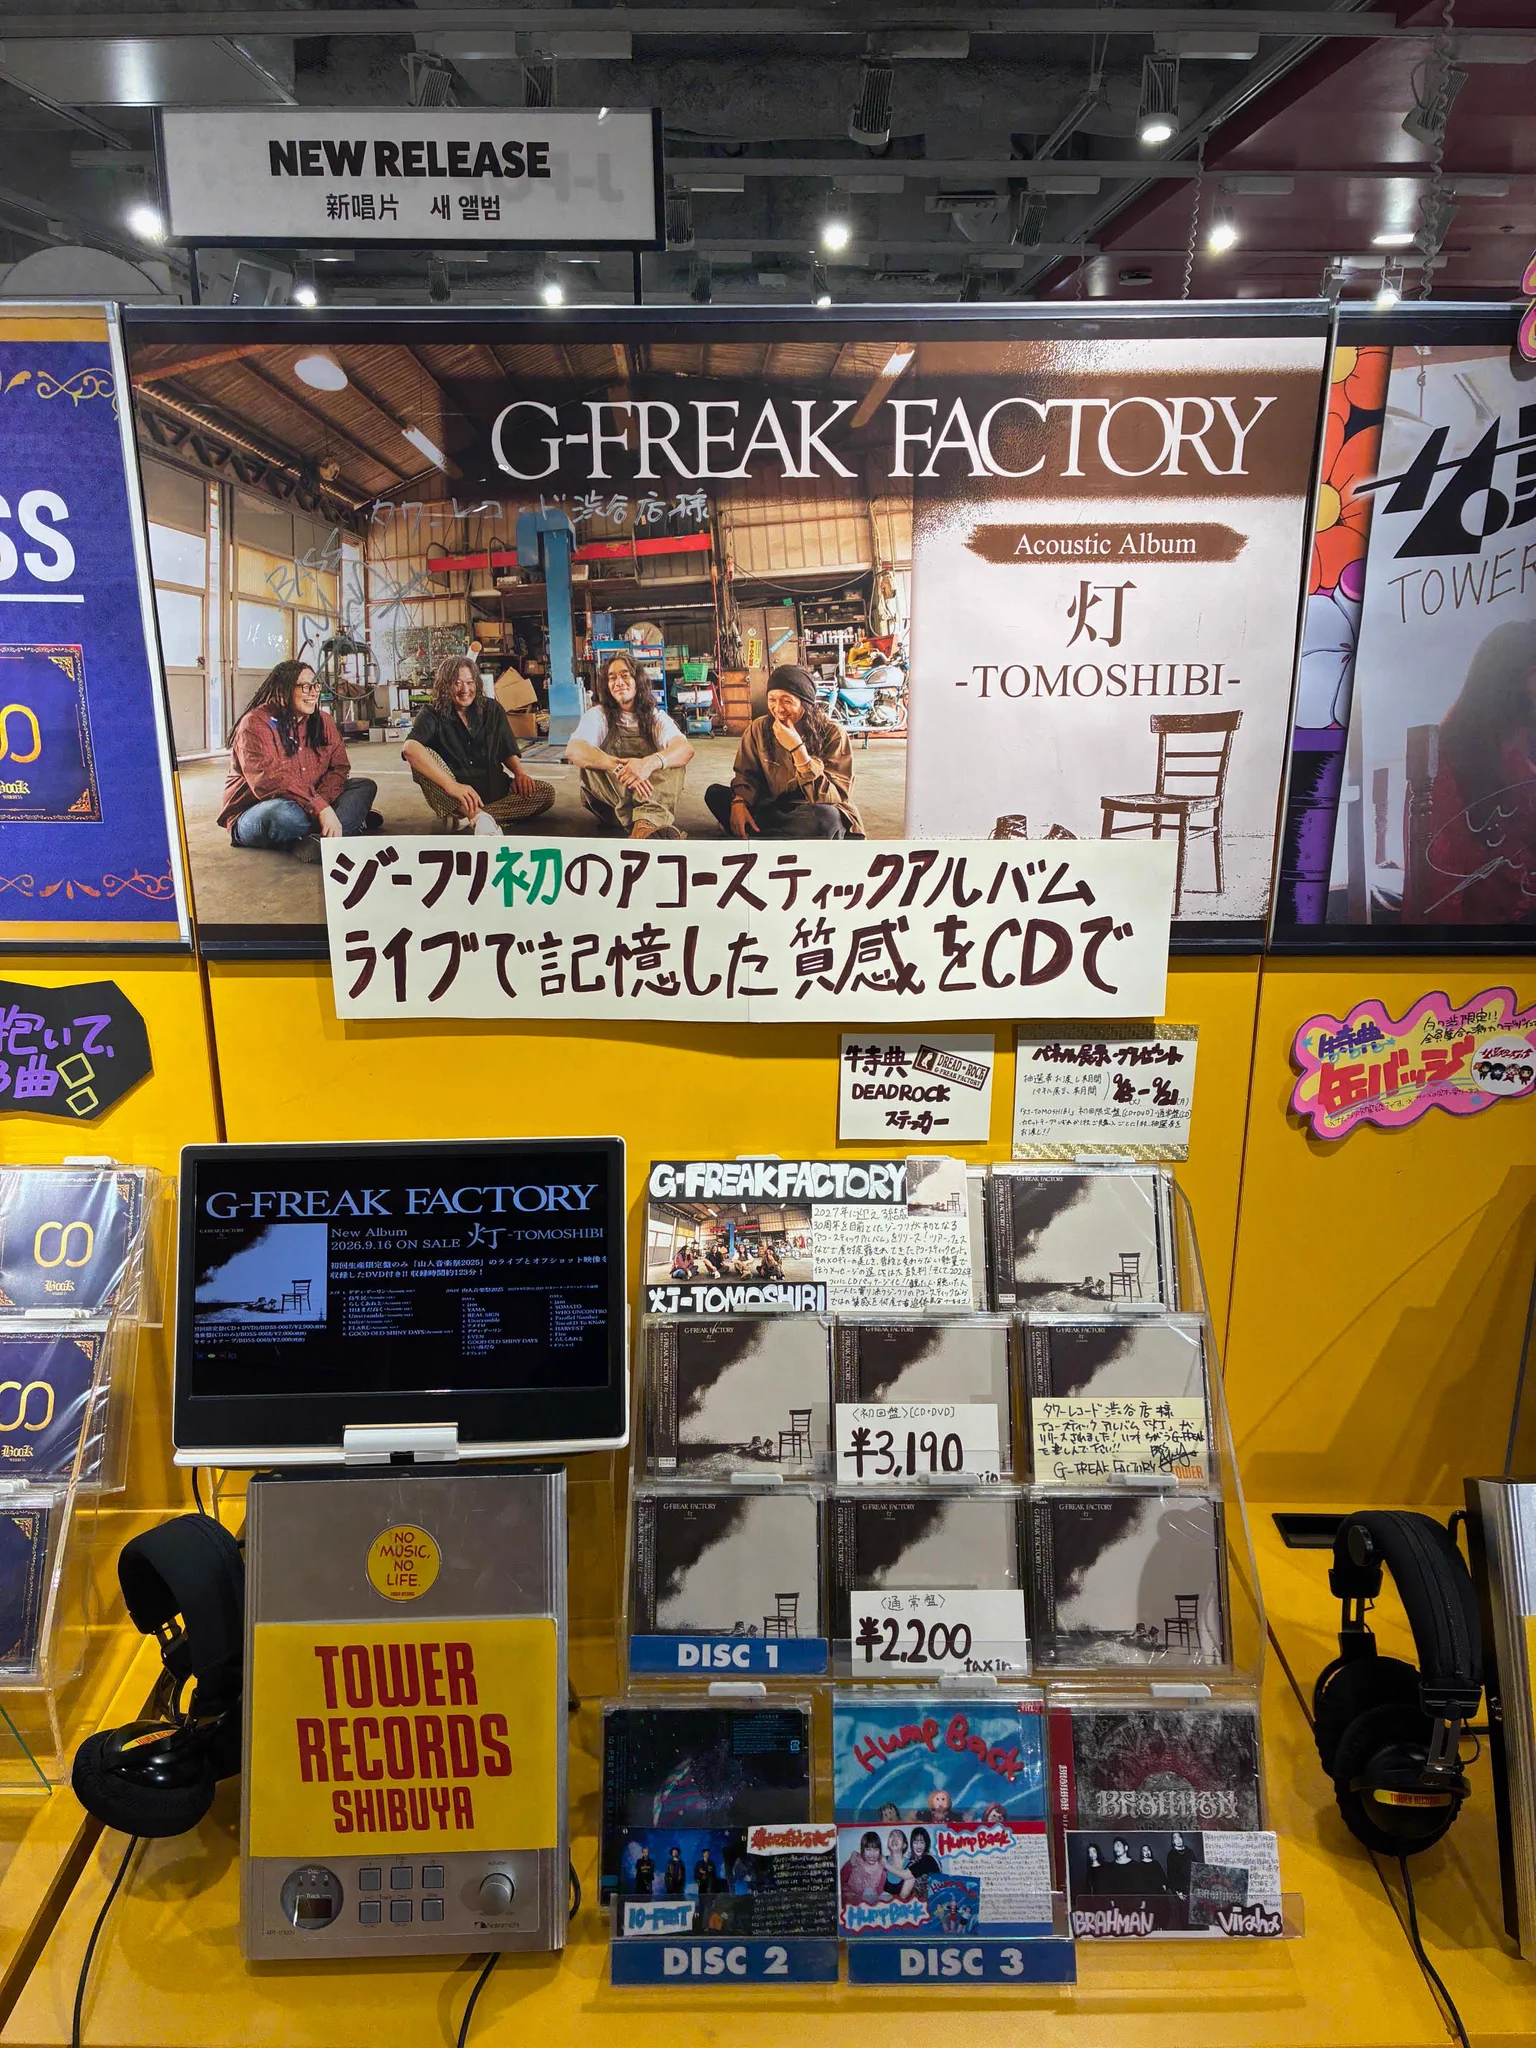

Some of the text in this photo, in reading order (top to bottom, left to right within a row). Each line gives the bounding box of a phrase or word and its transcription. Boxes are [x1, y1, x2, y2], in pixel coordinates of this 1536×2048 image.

[269, 140, 551, 178] NEW RELEASE
[326, 193, 399, 221] 新唱片
[429, 194, 502, 221] 새 앨범
[491, 397, 857, 481] G-FREAK
[887, 396, 1277, 479] FACTORY
[1014, 530, 1198, 556] Acoustic Album
[1066, 580, 1137, 648] 灯
[955, 662, 1241, 699] -TOMOSHIBI-
[329, 845, 1097, 912] ジーフリ初のアコースティックアルバム
[345, 914, 1134, 1003] ライブで記憶した質感をCDで
[1319, 1021, 1385, 1058] 特典
[844, 1045, 912, 1078] 特典
[851, 1083, 951, 1102] DEADROCK
[885, 1110, 949, 1135] ステッカー
[205, 1183, 599, 1219] G-FREAK FACTORY
[331, 1227, 408, 1238] New Album
[331, 1238, 461, 1250] 2026.9.16 ON SALE
[466, 1222, 507, 1250] 灯
[843, 1426, 964, 1478] ¥3,190
[395, 1531, 414, 1544] NO
[386, 1573, 421, 1587] LIFE.
[394, 1560, 414, 1572] NO
[855, 1615, 972, 1664] ¥2,200
[677, 1643, 779, 1668] DISC 1
[314, 1642, 479, 1710] TOWER
[296, 1713, 513, 1783] RECORDS
[853, 1718, 940, 1774] Hump
[945, 1713, 1025, 1783] Back
[333, 1786, 475, 1834] SHIBUYA
[938, 1829, 1012, 1856] Hump Back
[849, 1899, 927, 1927] Hump Back
[1072, 1908, 1155, 1935] BRAHMAN
[663, 1946, 789, 1976] DISC 2
[900, 1947, 1025, 1977] DISC 3
